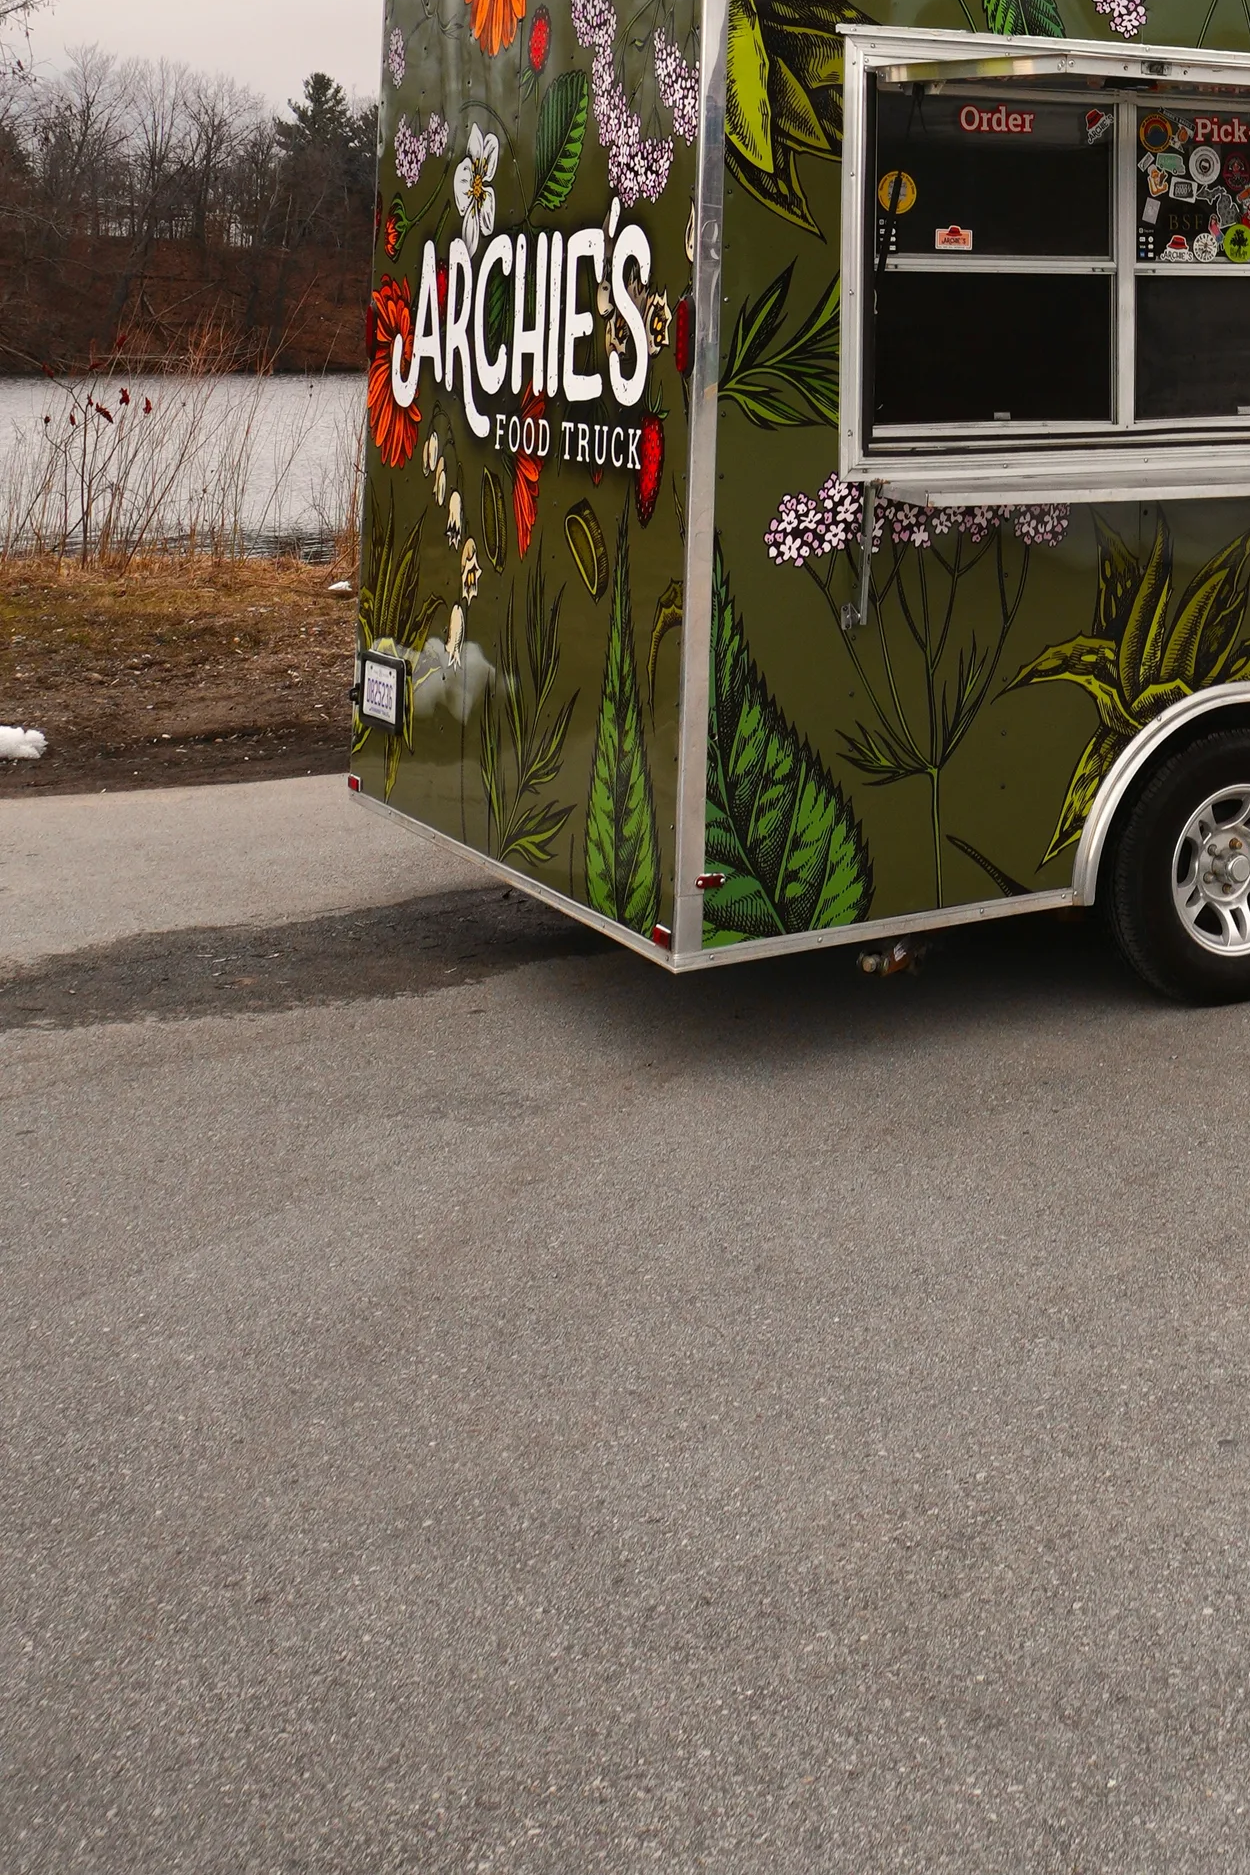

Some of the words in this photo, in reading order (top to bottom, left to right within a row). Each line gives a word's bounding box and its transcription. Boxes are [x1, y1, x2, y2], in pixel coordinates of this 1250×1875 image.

[959, 104, 1036, 133] Order
[1088, 114, 1115, 144] ARCHIE'S
[1160, 251, 1193, 262] ARCHIE'S
[391, 196, 652, 438] ARCHIE'S
[495, 414, 550, 457] FOOD
[562, 421, 642, 470] TRUCK
